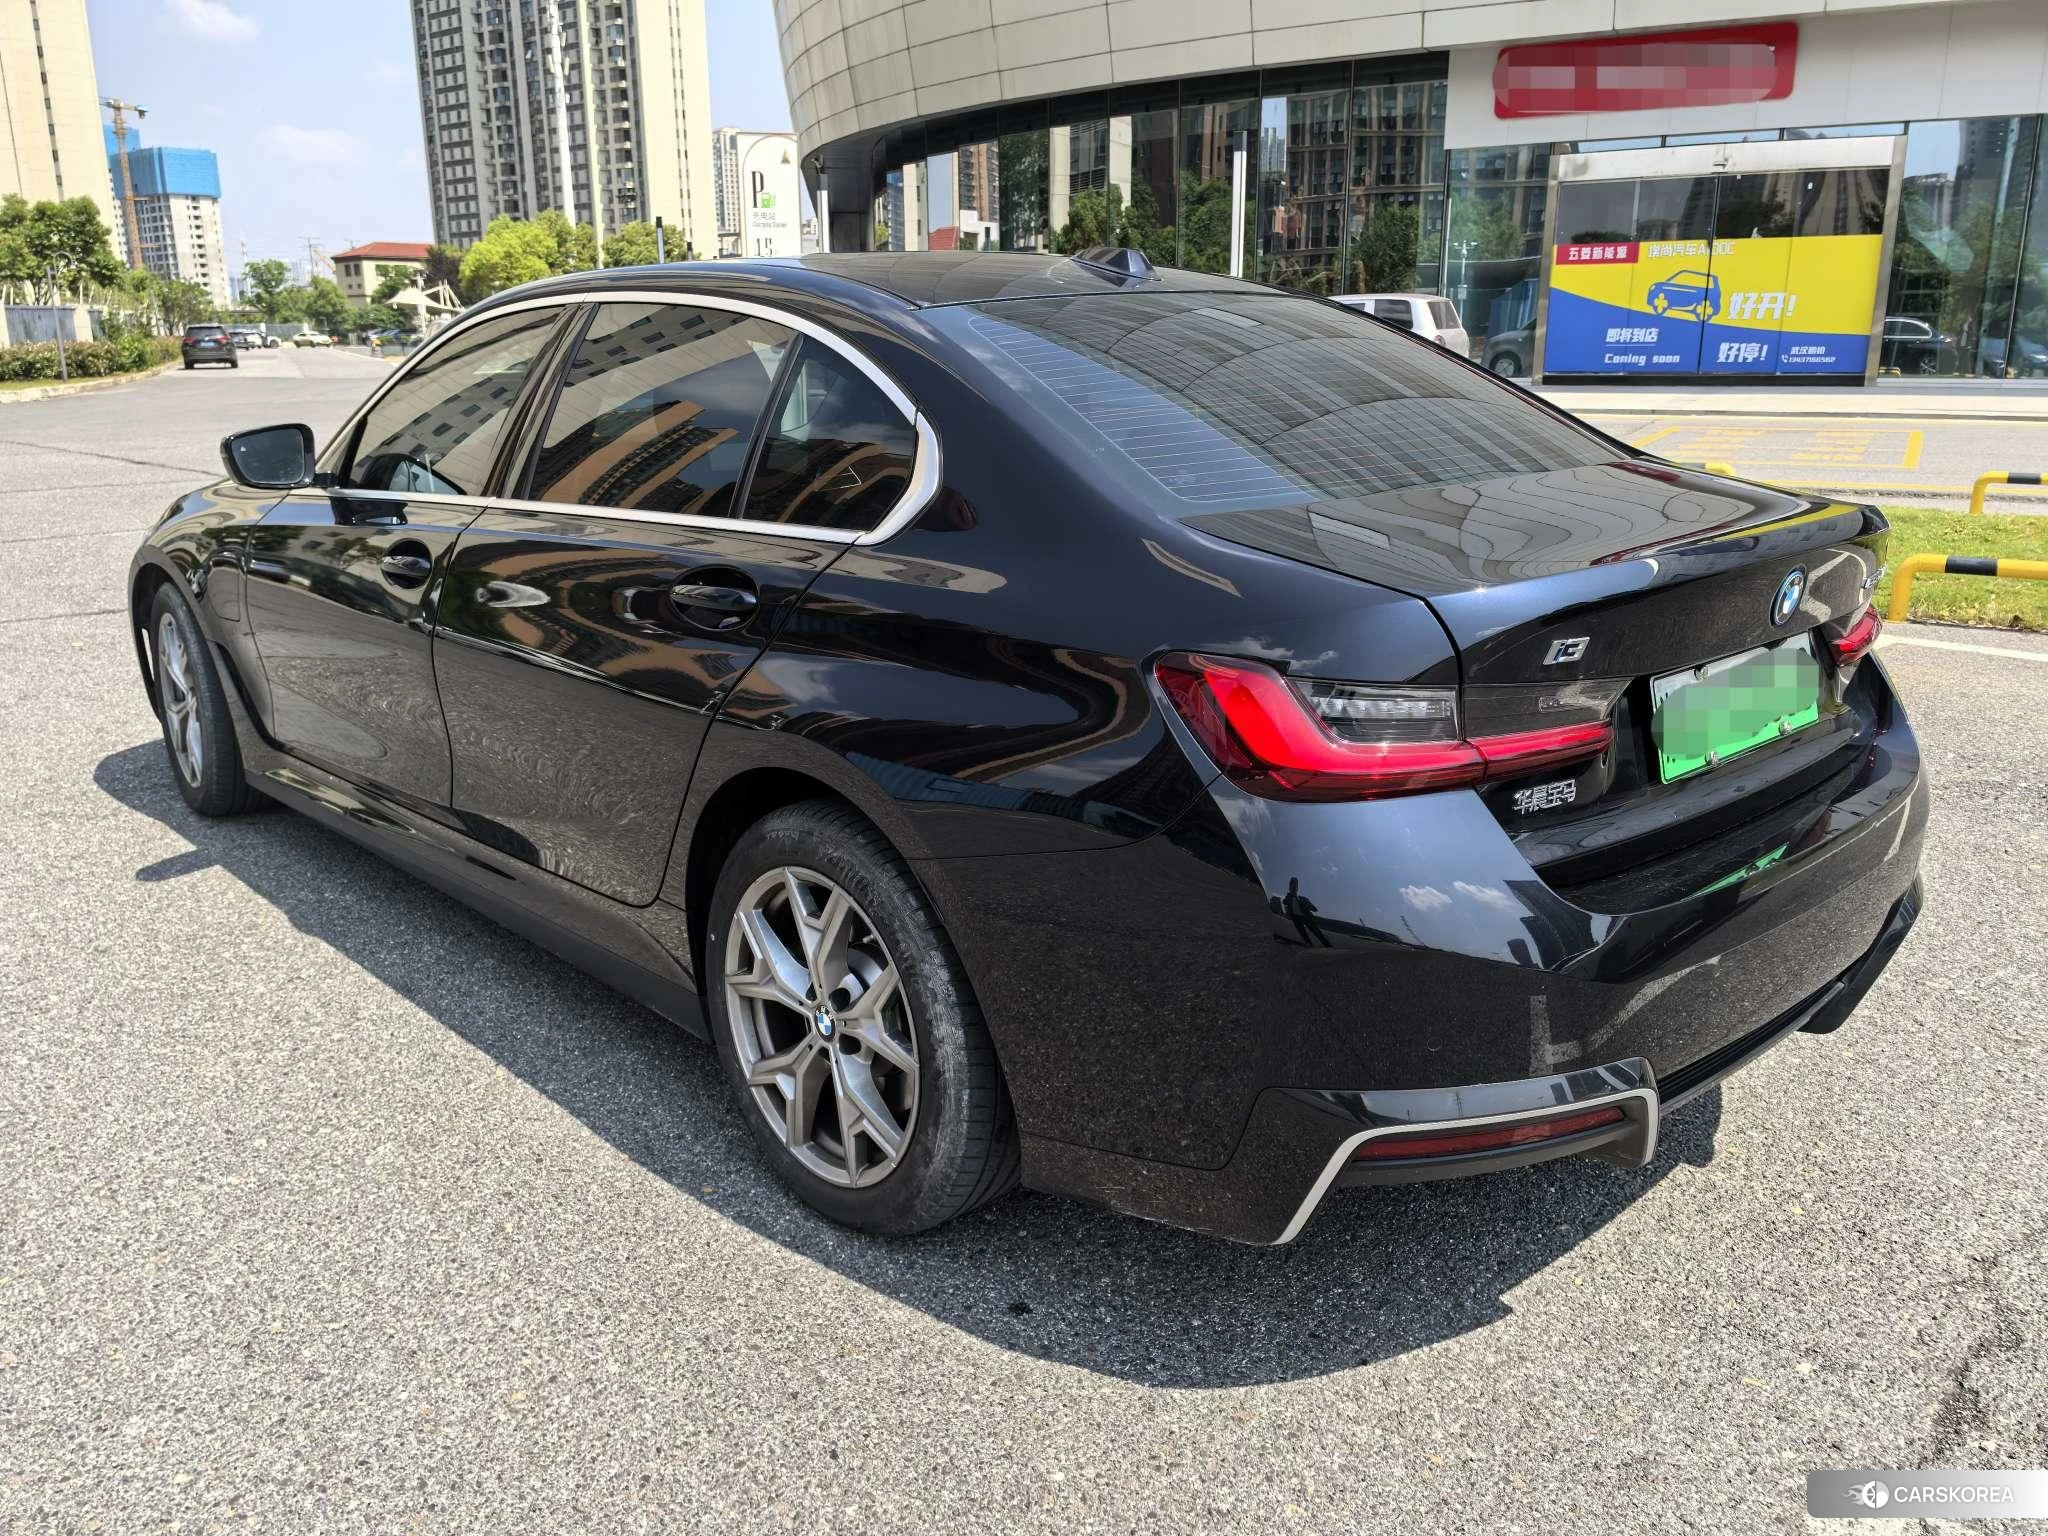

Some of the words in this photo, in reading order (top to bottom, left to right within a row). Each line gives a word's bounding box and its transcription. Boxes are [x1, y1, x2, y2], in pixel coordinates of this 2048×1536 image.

[752, 171, 764, 208] P
[1568, 246, 1628, 261] 五菱新能源
[1606, 327, 1660, 343] 即将到店
[1604, 353, 1647, 366] Coming
[1652, 355, 1680, 363] soon
[1543, 637, 1590, 665] i3
[1512, 779, 1577, 815] 华晨宝马
